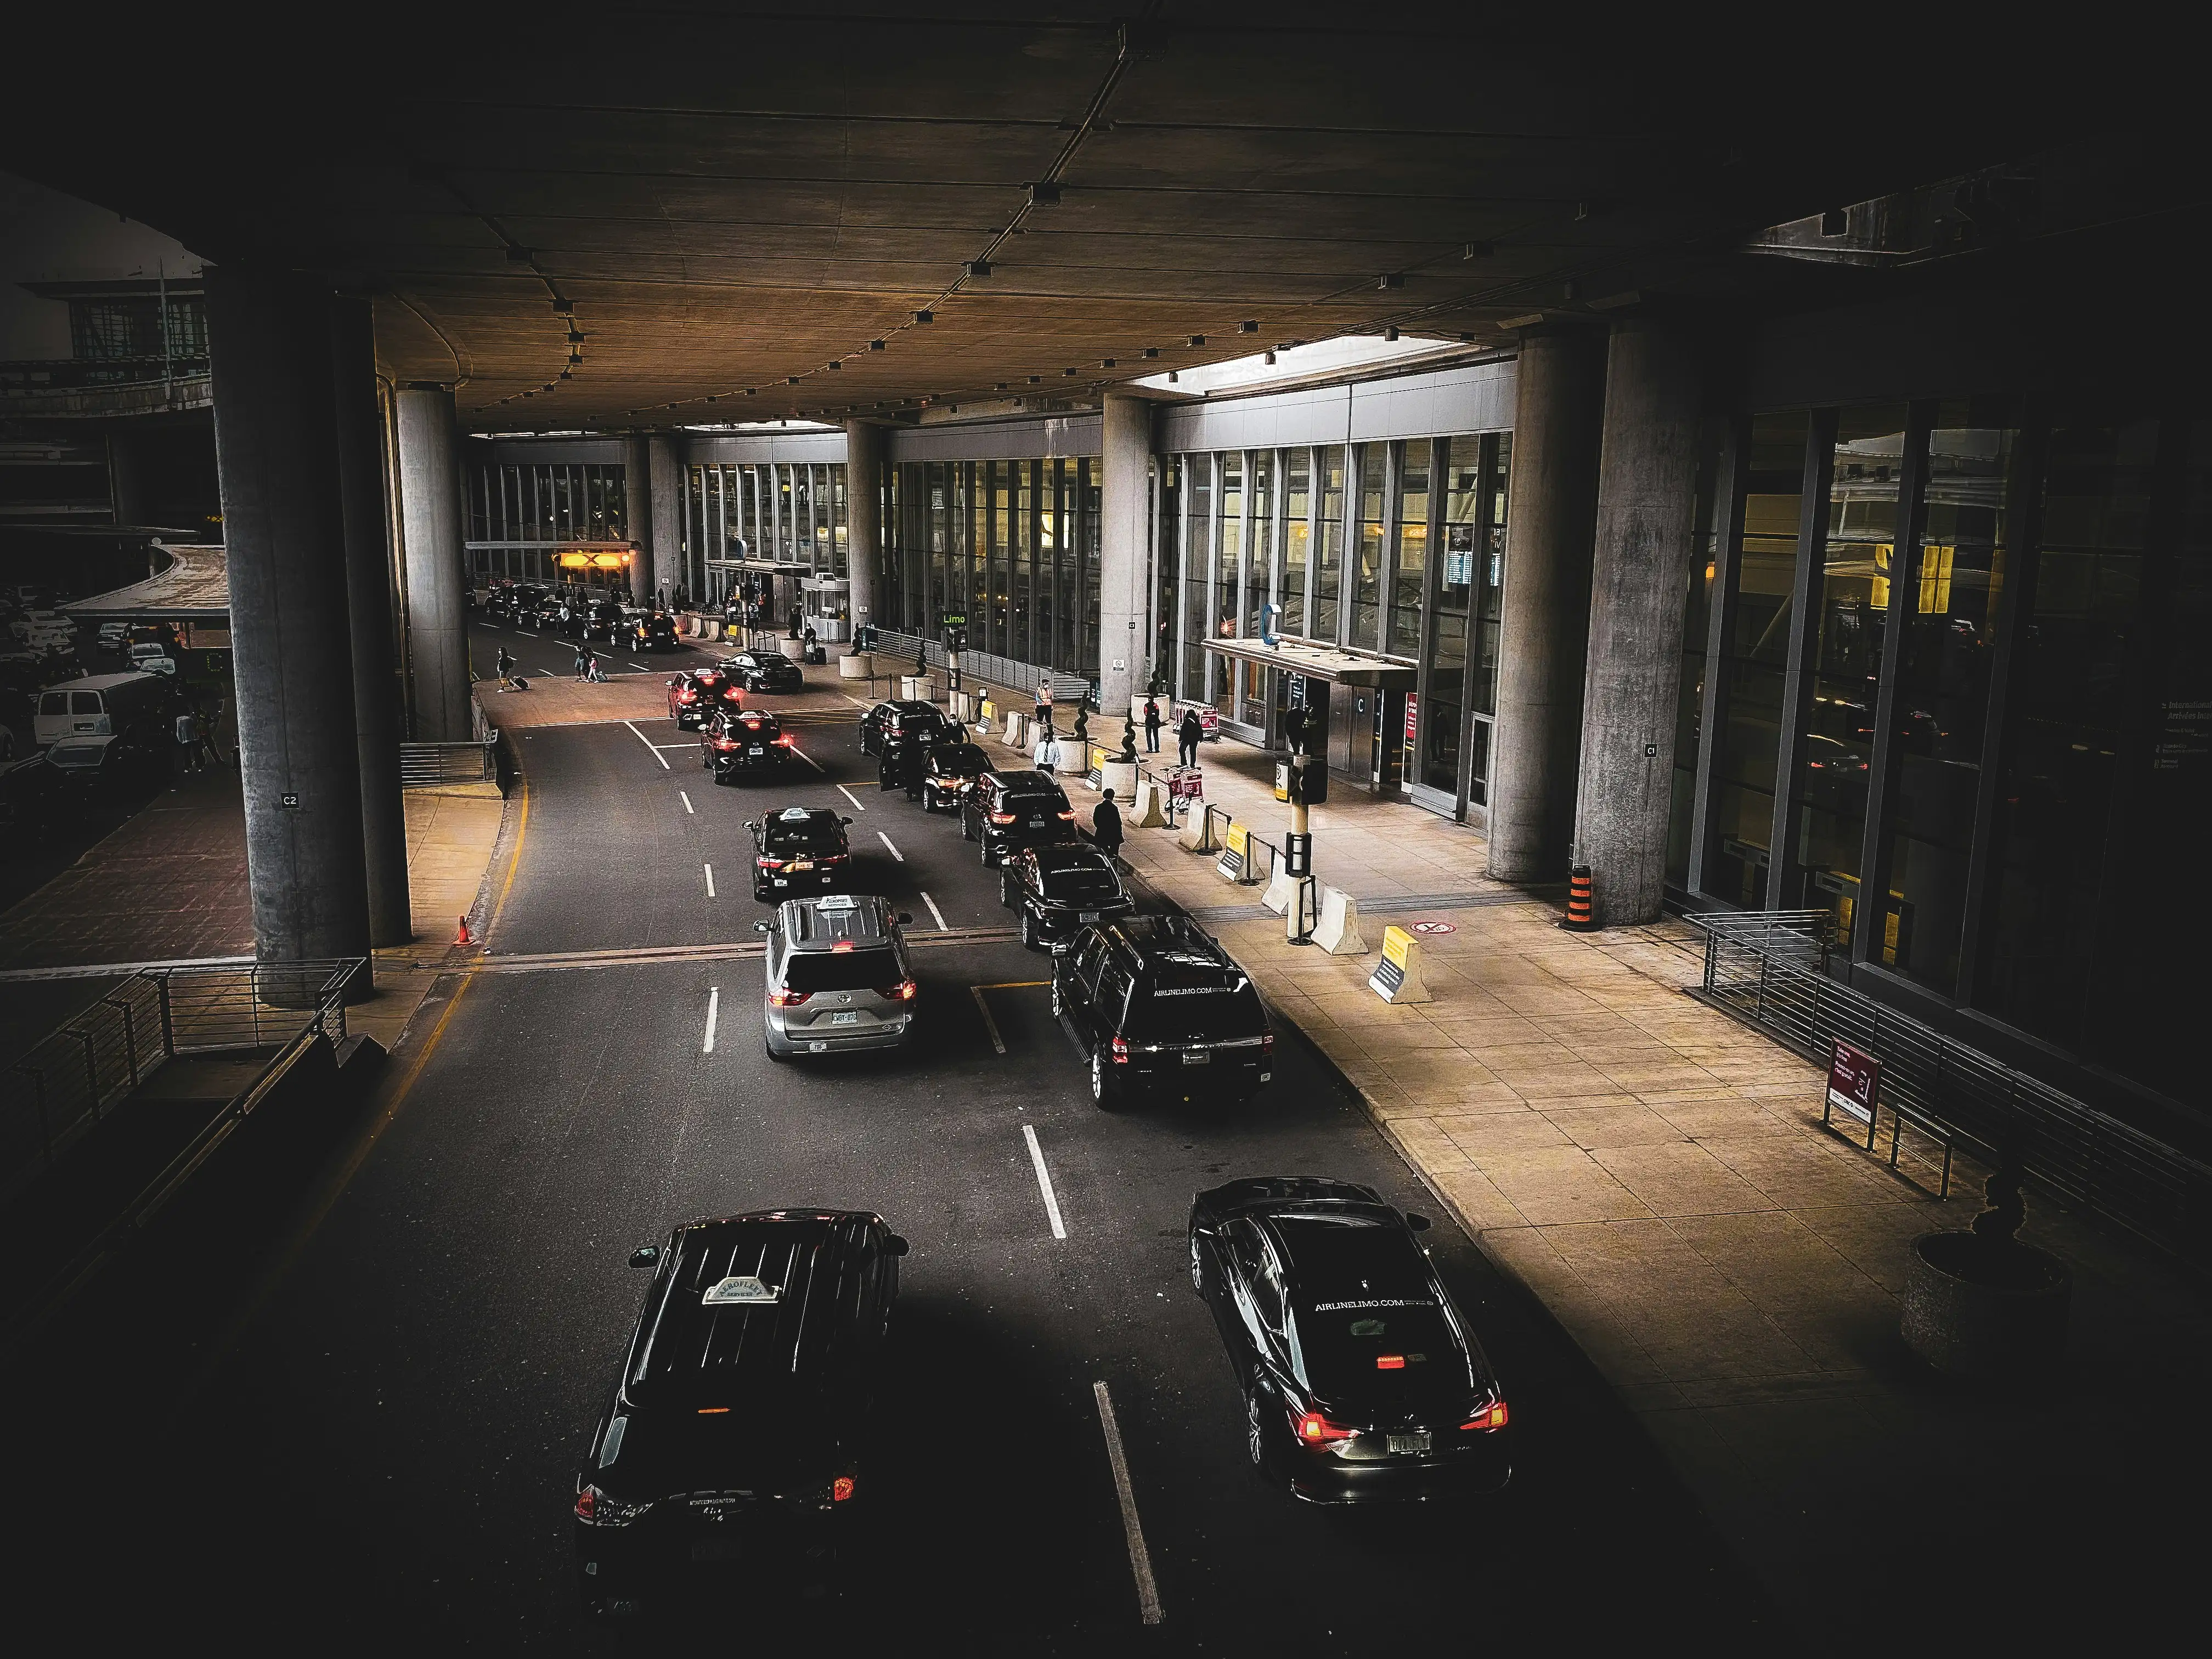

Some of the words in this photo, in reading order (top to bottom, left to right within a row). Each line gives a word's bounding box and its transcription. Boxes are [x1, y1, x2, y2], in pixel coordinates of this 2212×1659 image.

[944, 614, 965, 623] Limo
[284, 797, 297, 805] C2
[1154, 988, 1212, 997] AIRLINELIMO.COM
[1315, 1300, 1405, 1312] AIRLINELIMO.COM
